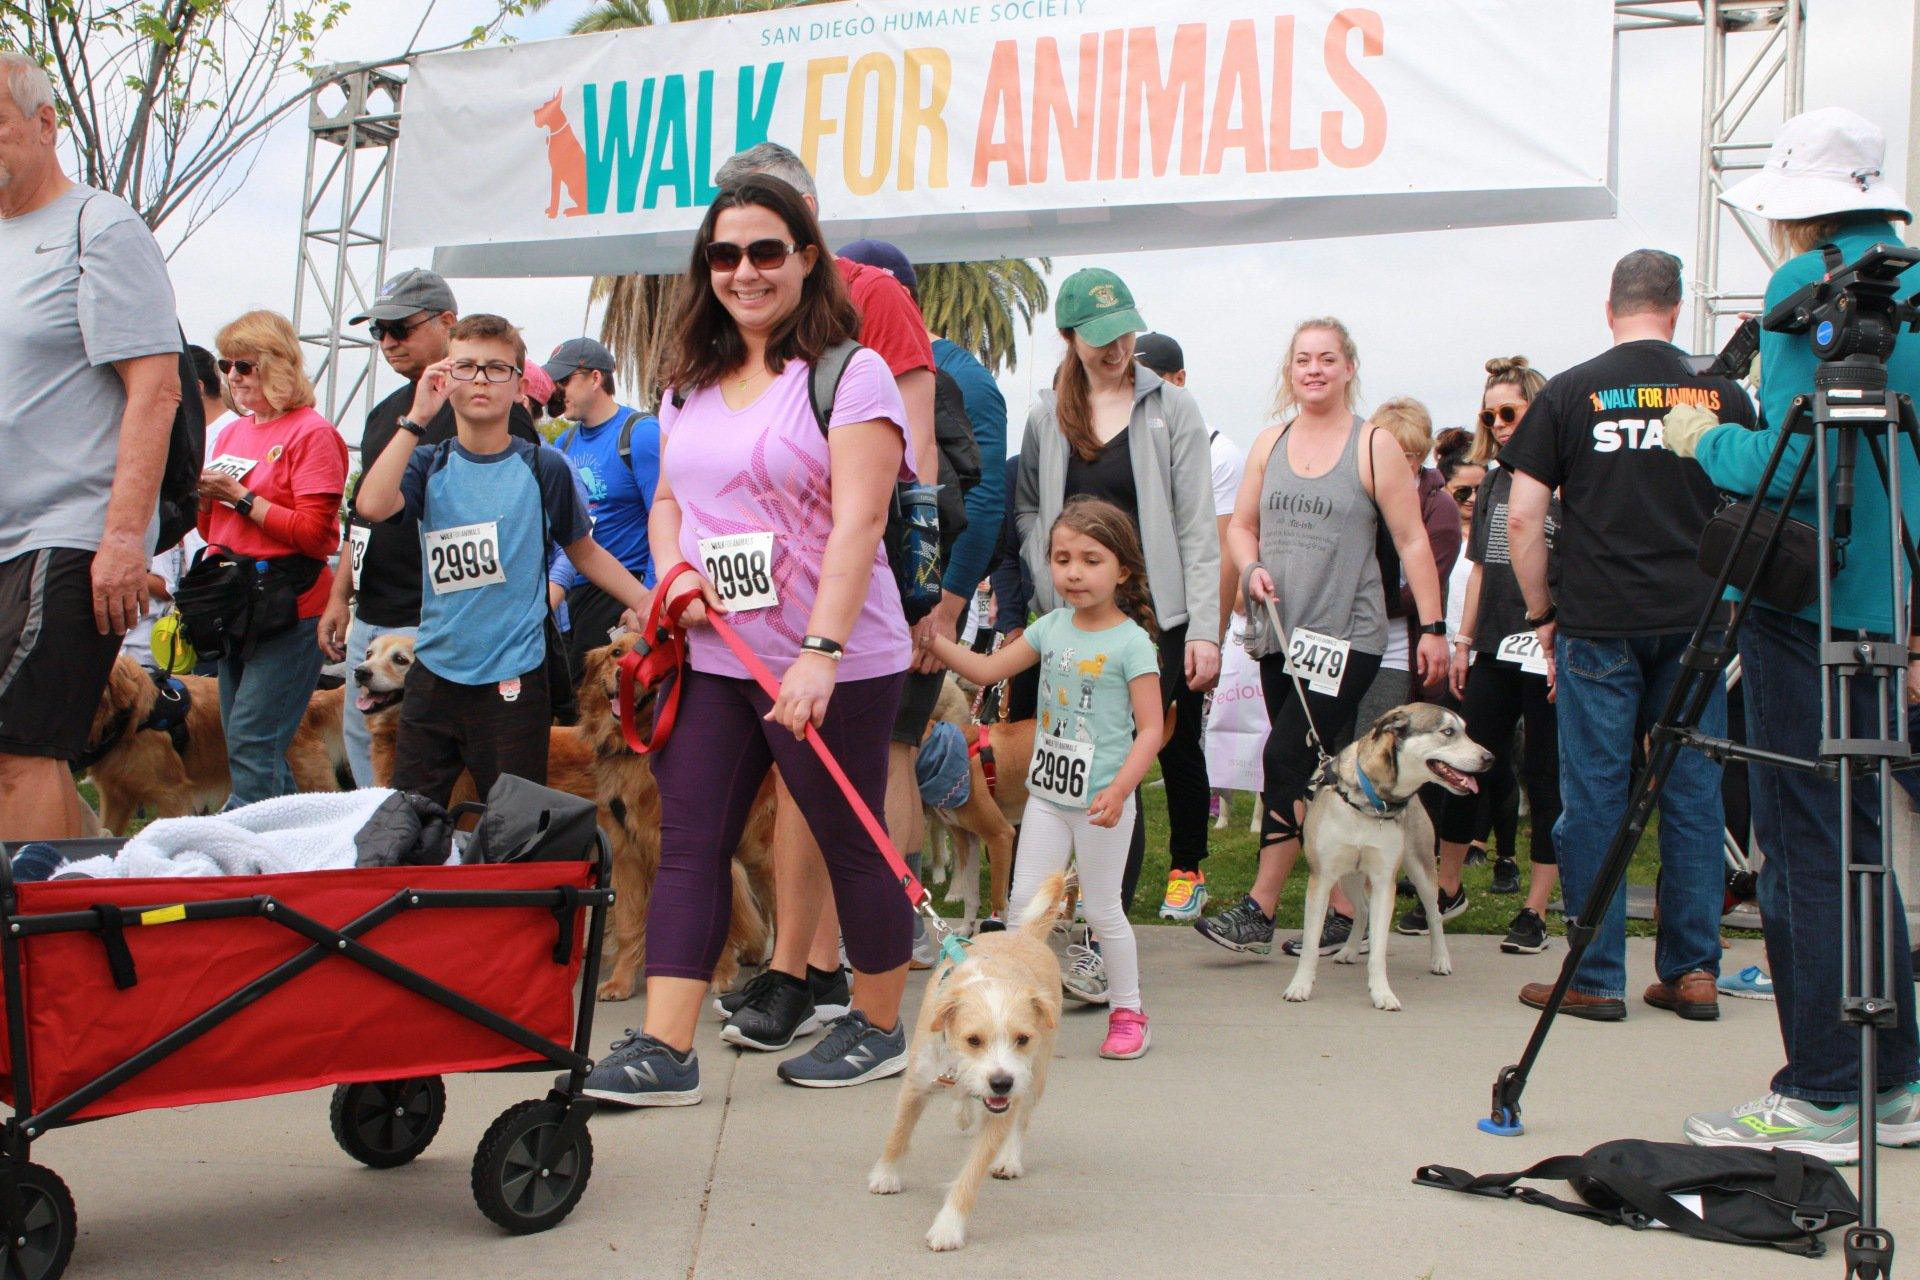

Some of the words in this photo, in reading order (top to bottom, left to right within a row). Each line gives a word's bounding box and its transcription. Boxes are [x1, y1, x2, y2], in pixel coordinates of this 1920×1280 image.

[760, 25, 801, 47] SAN
[809, 16, 876, 41] DIEGO
[883, 6, 980, 32] HUMANE
[989, 0, 1087, 23] SOCIETY
[582, 61, 785, 214] WALK
[801, 46, 952, 197] FOR
[970, 8, 1388, 188] ANIMALS
[1598, 387, 1637, 410] WALK
[1637, 387, 1664, 408] FOR
[1664, 387, 1721, 411] ANIMALS
[1592, 418, 1667, 453] STA
[1269, 491, 1333, 521] fit(ish)
[431, 538, 498, 584] 2999
[706, 549, 770, 600] 2998
[1291, 639, 1344, 679] 2479
[1503, 635, 1541, 658] 227
[1216, 682, 1264, 705] eciou
[1031, 747, 1086, 798] 2996
